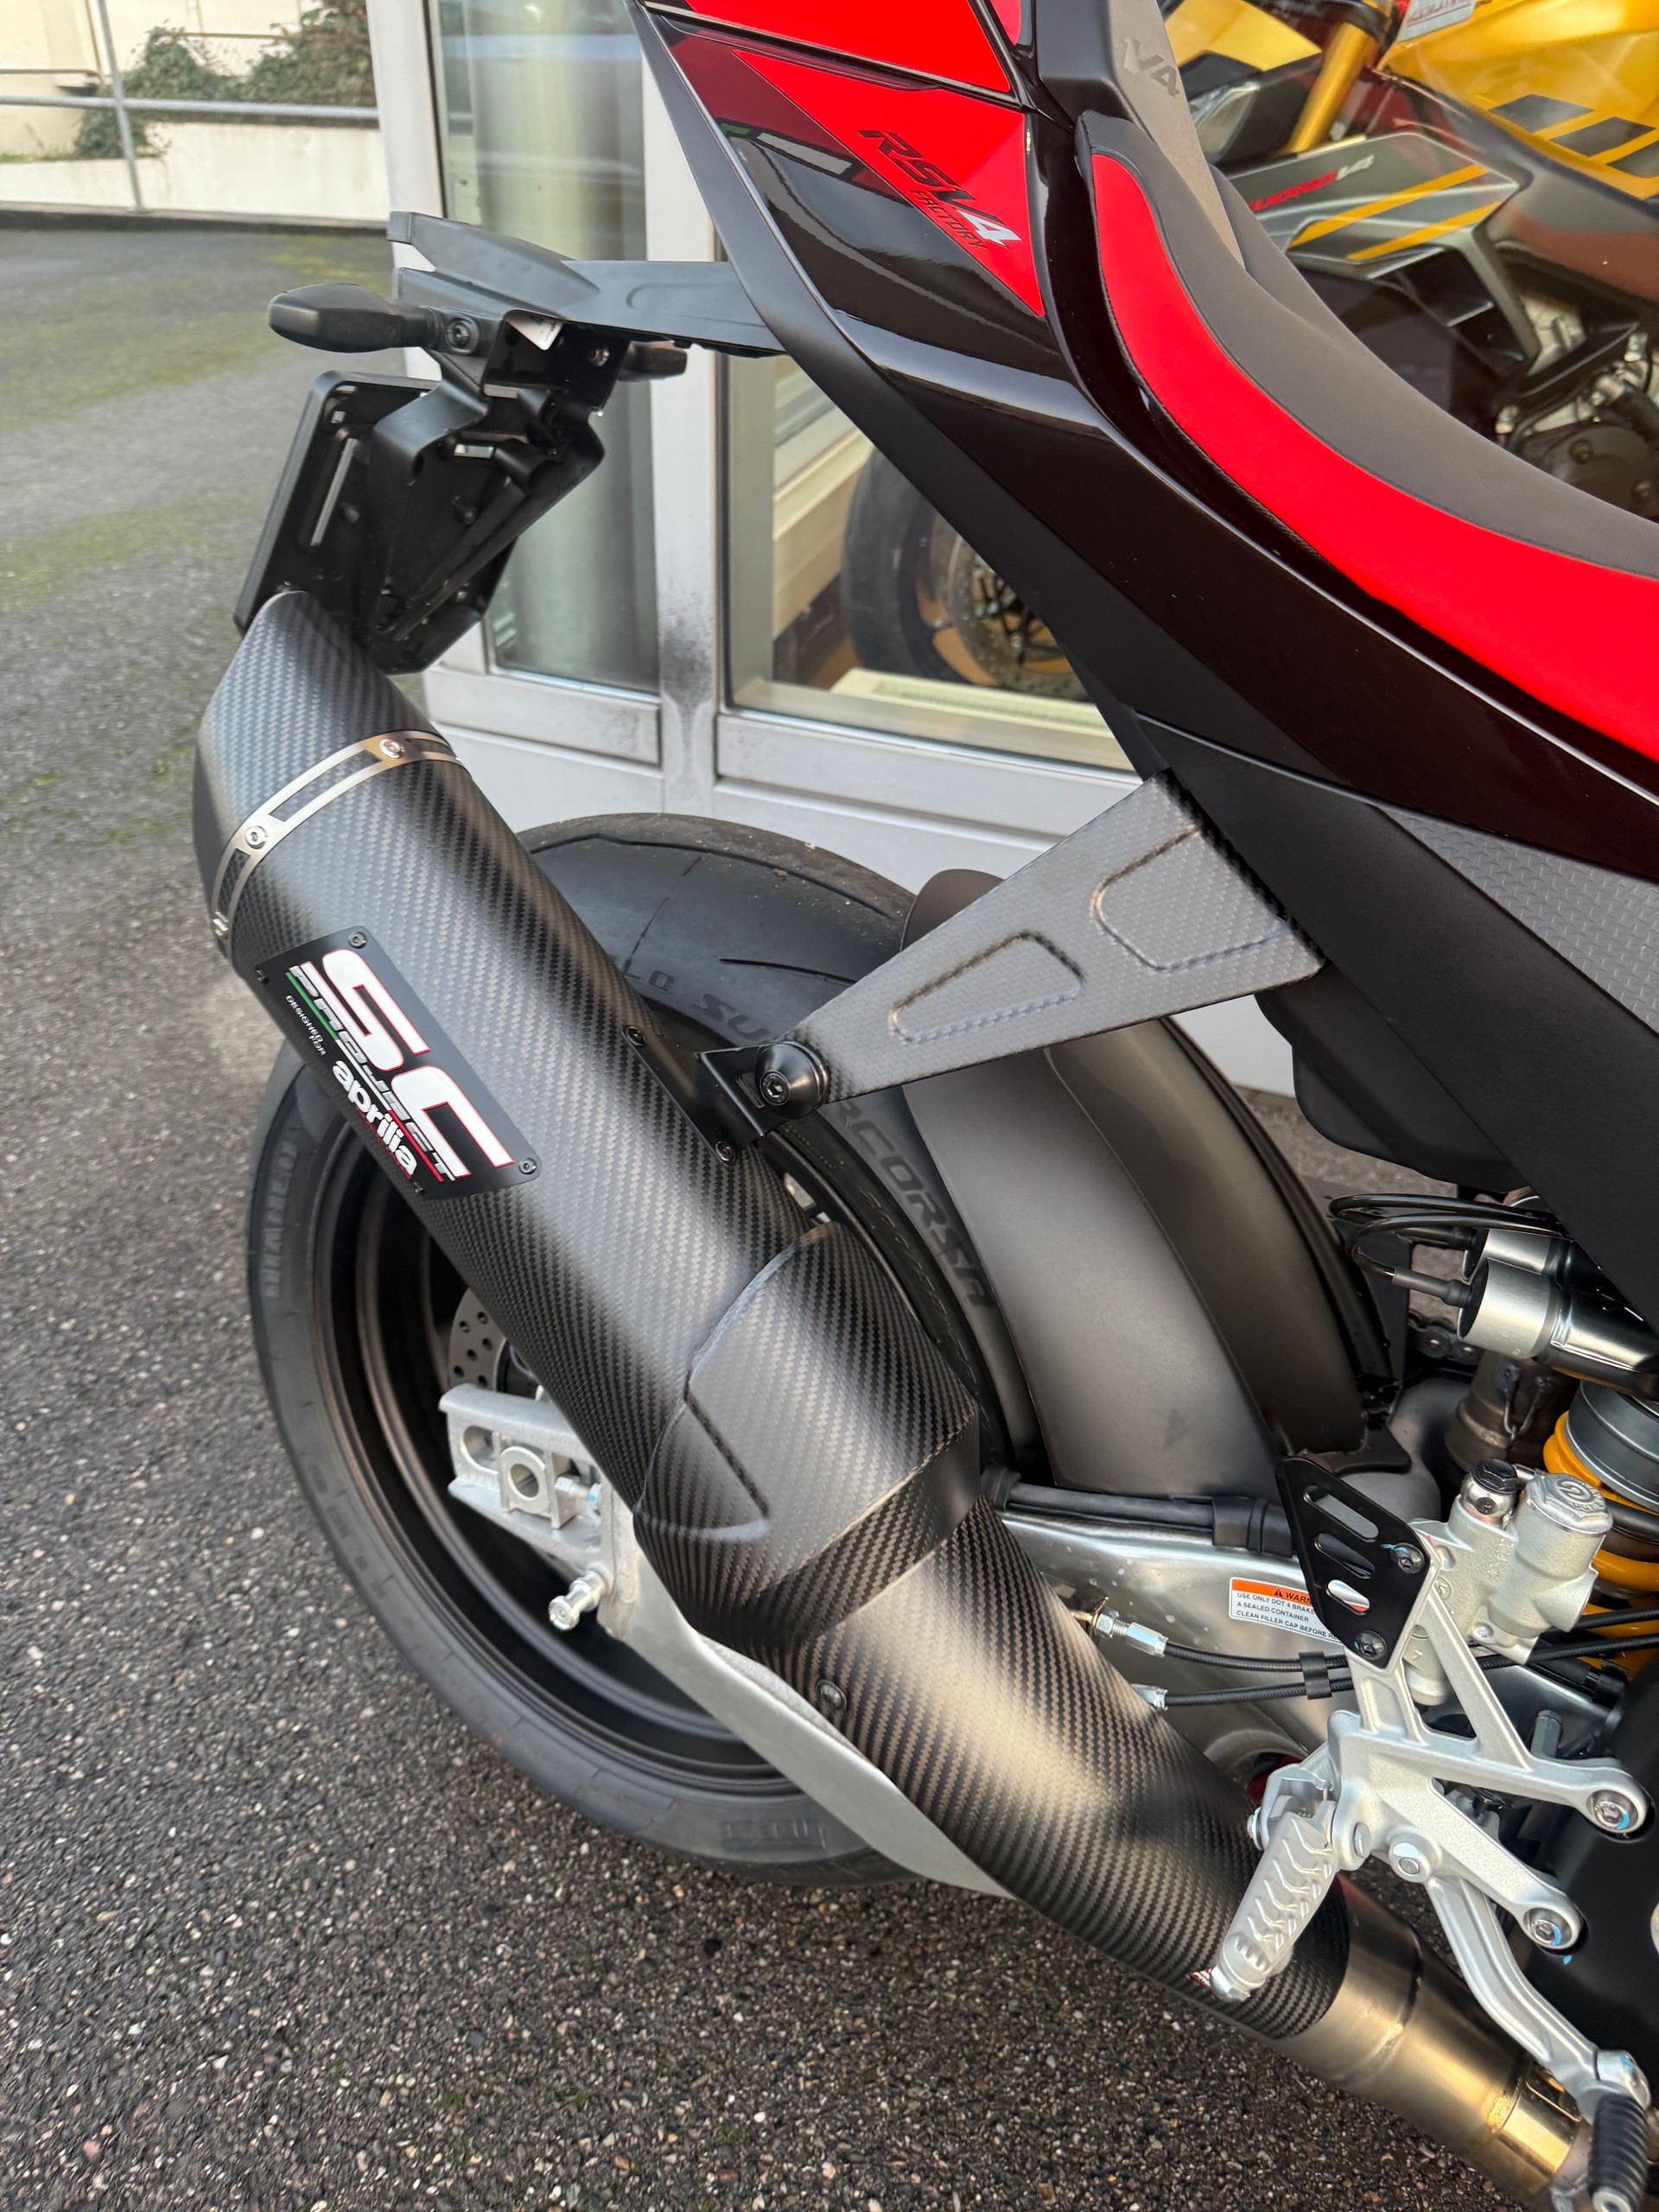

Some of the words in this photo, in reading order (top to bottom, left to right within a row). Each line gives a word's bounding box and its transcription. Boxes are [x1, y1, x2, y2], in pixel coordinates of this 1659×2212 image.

[857, 130, 1024, 249] RSV4
[908, 189, 988, 249] FACTORY
[285, 995, 324, 1043] DESIGNED
[308, 1035, 327, 1056] FOR
[289, 965, 456, 1181] PROJECT
[299, 949, 516, 1179] SC
[332, 1060, 417, 1176] aprilia
[1236, 1610, 1259, 1618] CLEAN
[1260, 1614, 1283, 1624] FILLER
[1300, 1624, 1327, 1637] BEFORE
[1243, 1602, 1270, 1611] SEALED
[1271, 1608, 1309, 1622] CONTAINER
[1253, 1594, 1269, 1603] ONLY
